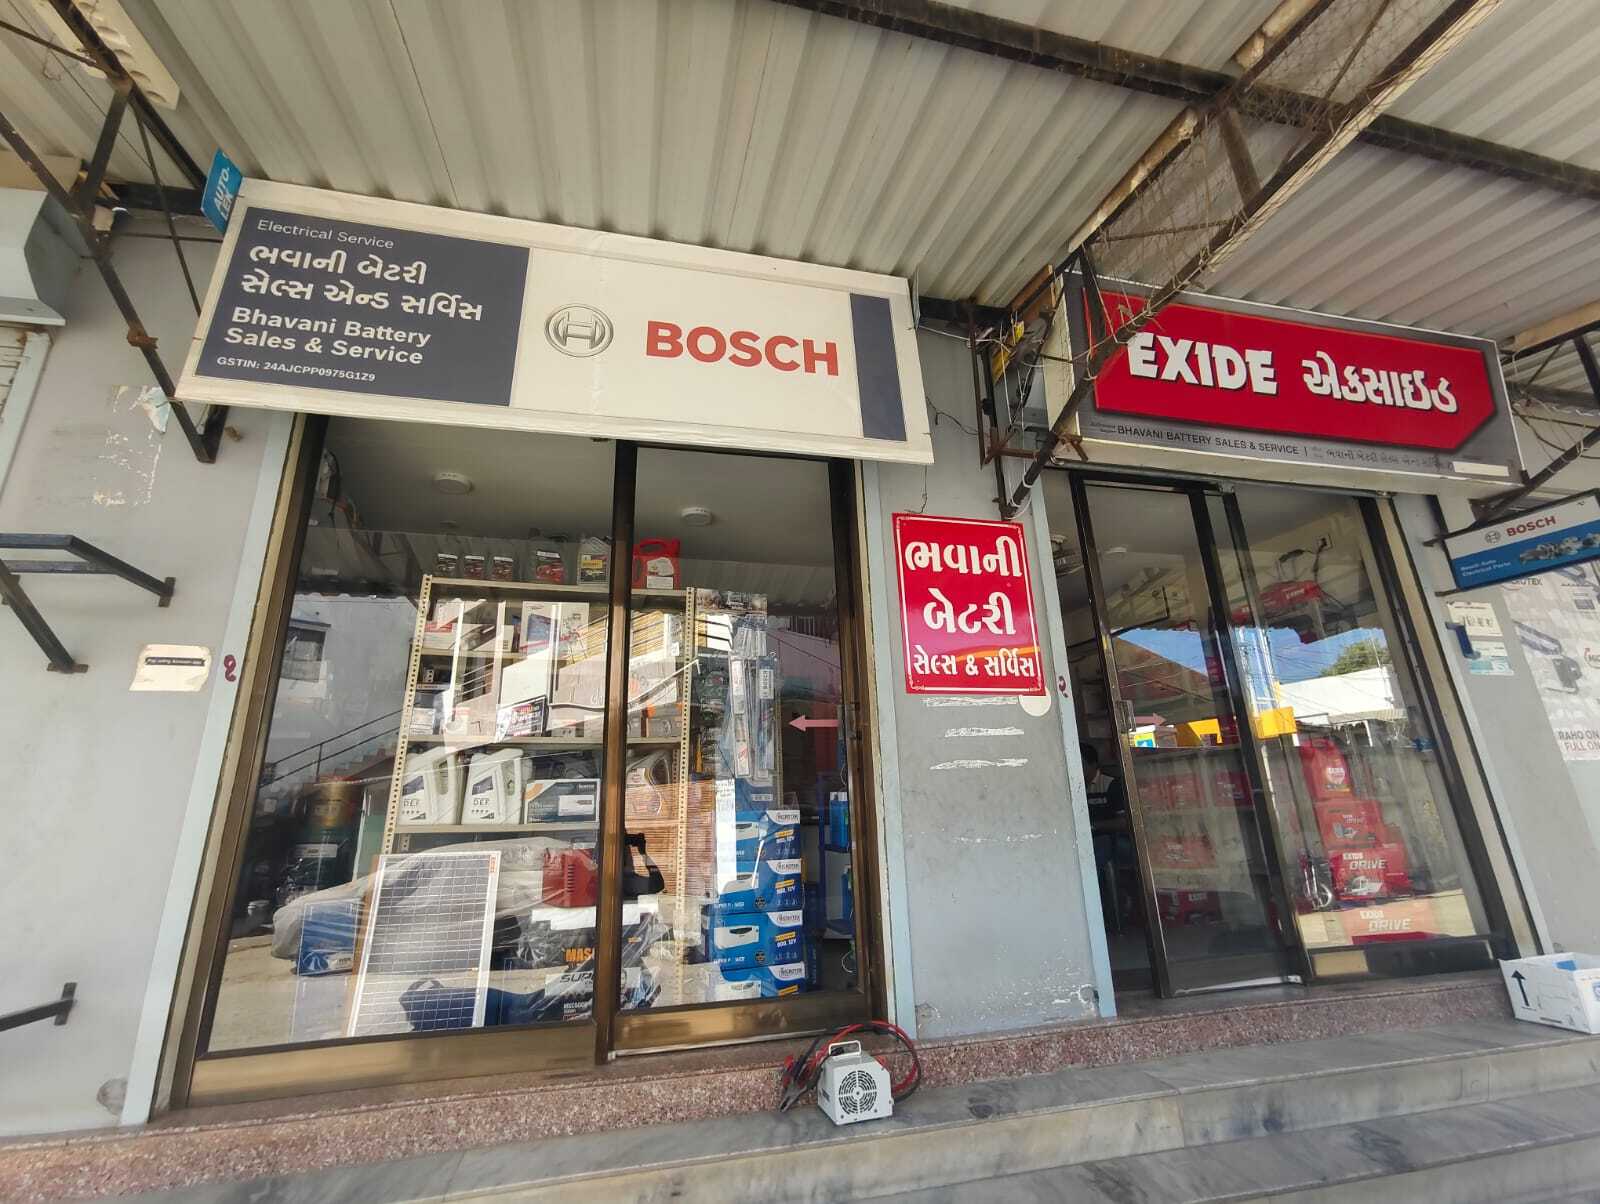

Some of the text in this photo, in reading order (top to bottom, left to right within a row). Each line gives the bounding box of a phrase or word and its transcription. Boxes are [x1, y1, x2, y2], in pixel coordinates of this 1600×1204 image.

[257, 219, 394, 249] Electrical Service
[250, 245, 427, 285] ભવાની બેટરી
[241, 268, 483, 321] સેલ્સ એન્ડ સર્વિસ
[232, 307, 432, 347] Bhavani Battery
[216, 355, 260, 370] GSTIN:
[224, 328, 423, 365] Sales & Service
[645, 320, 840, 377] BOSCH
[1127, 332, 1279, 395] EXIDE
[1117, 425, 1163, 440] BHAVANI
[1167, 431, 1211, 445] BATTERY
[1215, 437, 1247, 450] SALES
[1249, 440, 1257, 450] &
[1258, 443, 1301, 455] SERVICE
[1506, 515, 1557, 538] BOSCH
[904, 535, 1023, 577] ભવાની
[923, 587, 1017, 636] બેટરી
[913, 645, 1036, 678] સેલ્સ & સર્વિસ
[1350, 859, 1386, 870] DRIVE
[1369, 919, 1411, 931] DRIVE
